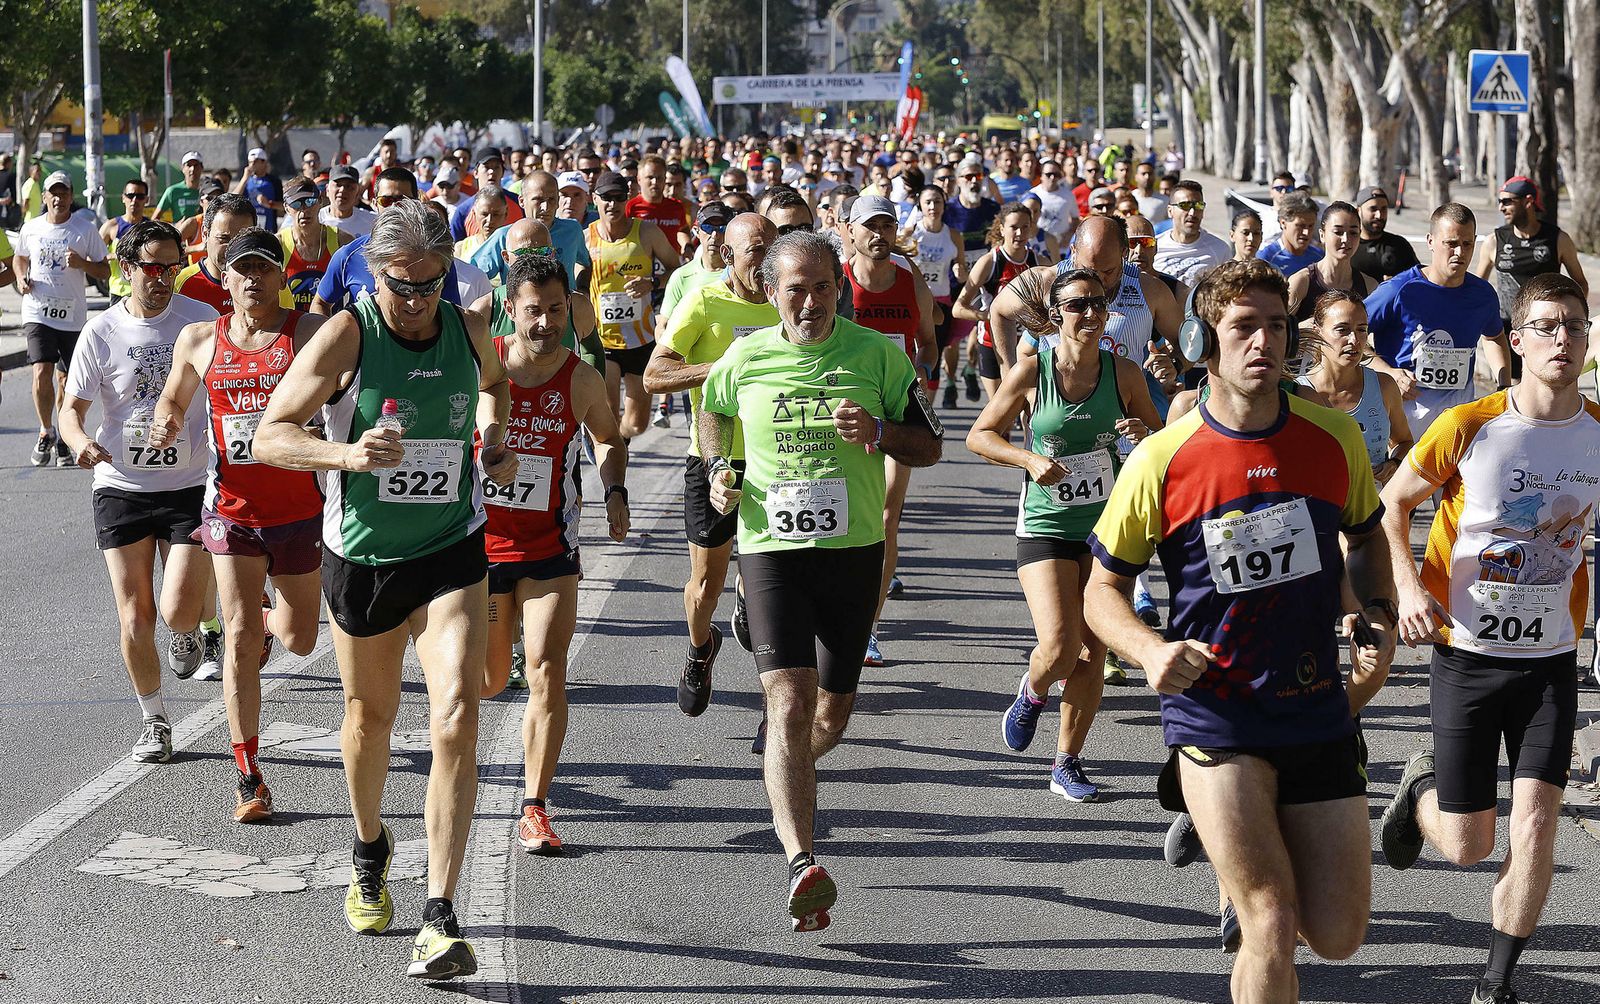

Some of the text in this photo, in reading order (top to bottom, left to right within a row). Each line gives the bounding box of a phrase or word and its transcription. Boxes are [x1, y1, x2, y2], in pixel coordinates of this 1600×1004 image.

[747, 77, 863, 90] CARRERA DE LA PRENSA
[293, 292, 312, 304] Mál
[42, 307, 67, 319] 180
[604, 306, 635, 320] 624
[212, 378, 256, 390] CLÍNICAS
[1421, 367, 1459, 385] 598
[226, 389, 273, 412] Véle
[775, 429, 835, 443] De Oficio
[129, 446, 178, 466] 728
[777, 441, 836, 455] Abogado
[1509, 469, 1526, 493] 3
[1527, 472, 1543, 482] Trail
[1555, 469, 1568, 481] La
[387, 471, 449, 496] 522
[482, 477, 535, 503] 647
[1057, 476, 1104, 502] 841
[1526, 481, 1561, 491] Nocturno
[775, 509, 838, 533] 363
[1215, 517, 1250, 529] CARRERA
[1261, 511, 1272, 519] LA
[1272, 503, 1299, 516] PRENSA
[1221, 542, 1295, 585] 197
[1486, 584, 1516, 592] CARRERA
[1477, 615, 1543, 642] 204
